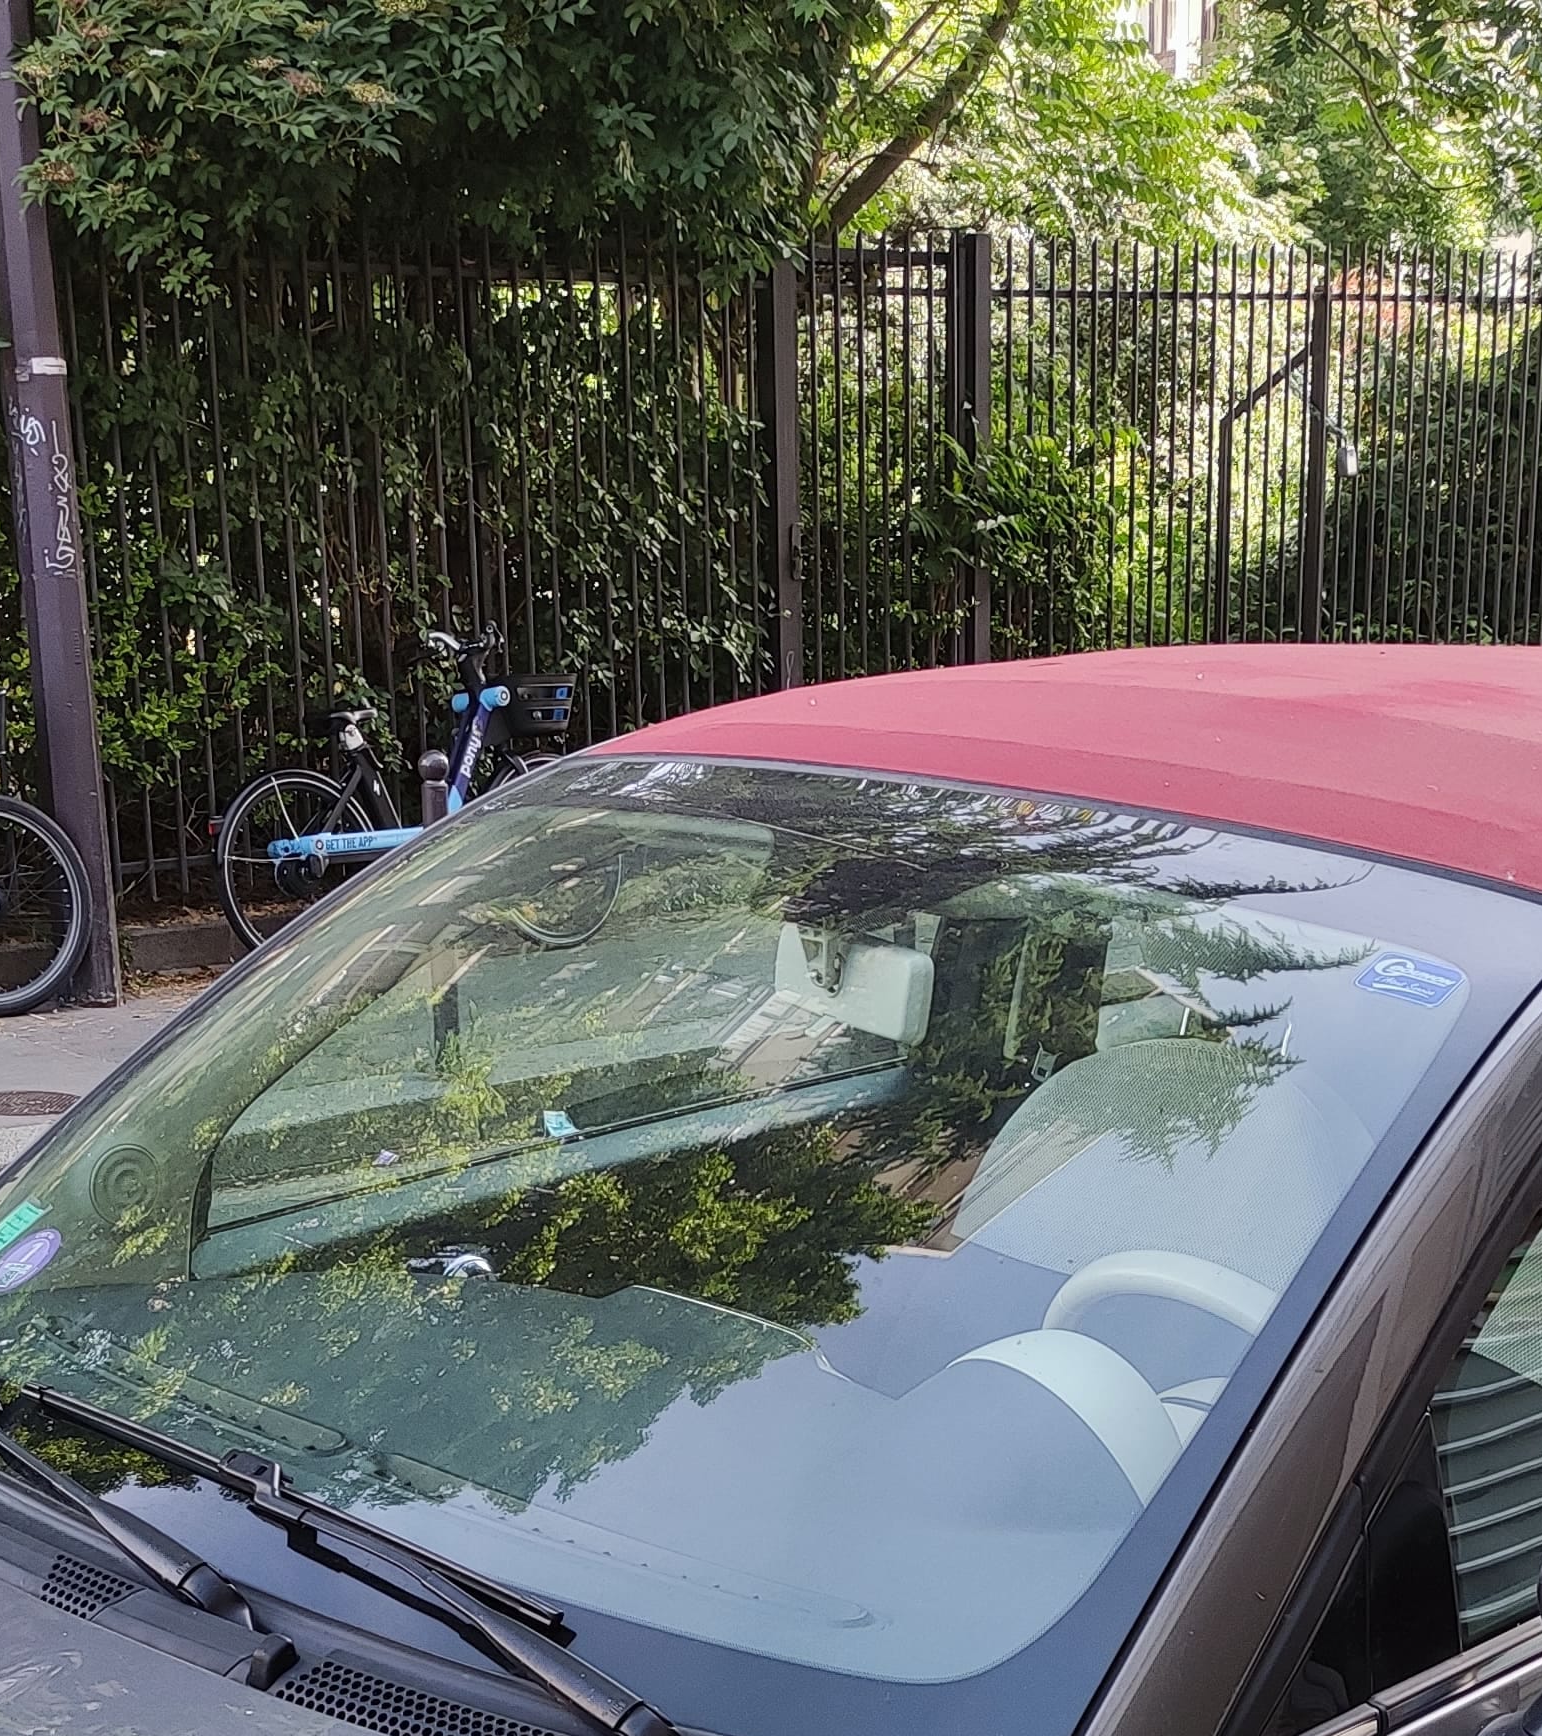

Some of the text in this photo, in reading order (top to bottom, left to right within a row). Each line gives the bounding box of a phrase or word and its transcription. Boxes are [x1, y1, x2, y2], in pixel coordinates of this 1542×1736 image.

[460, 734, 482, 778] pony
[325, 835, 373, 850] GET THE APP
